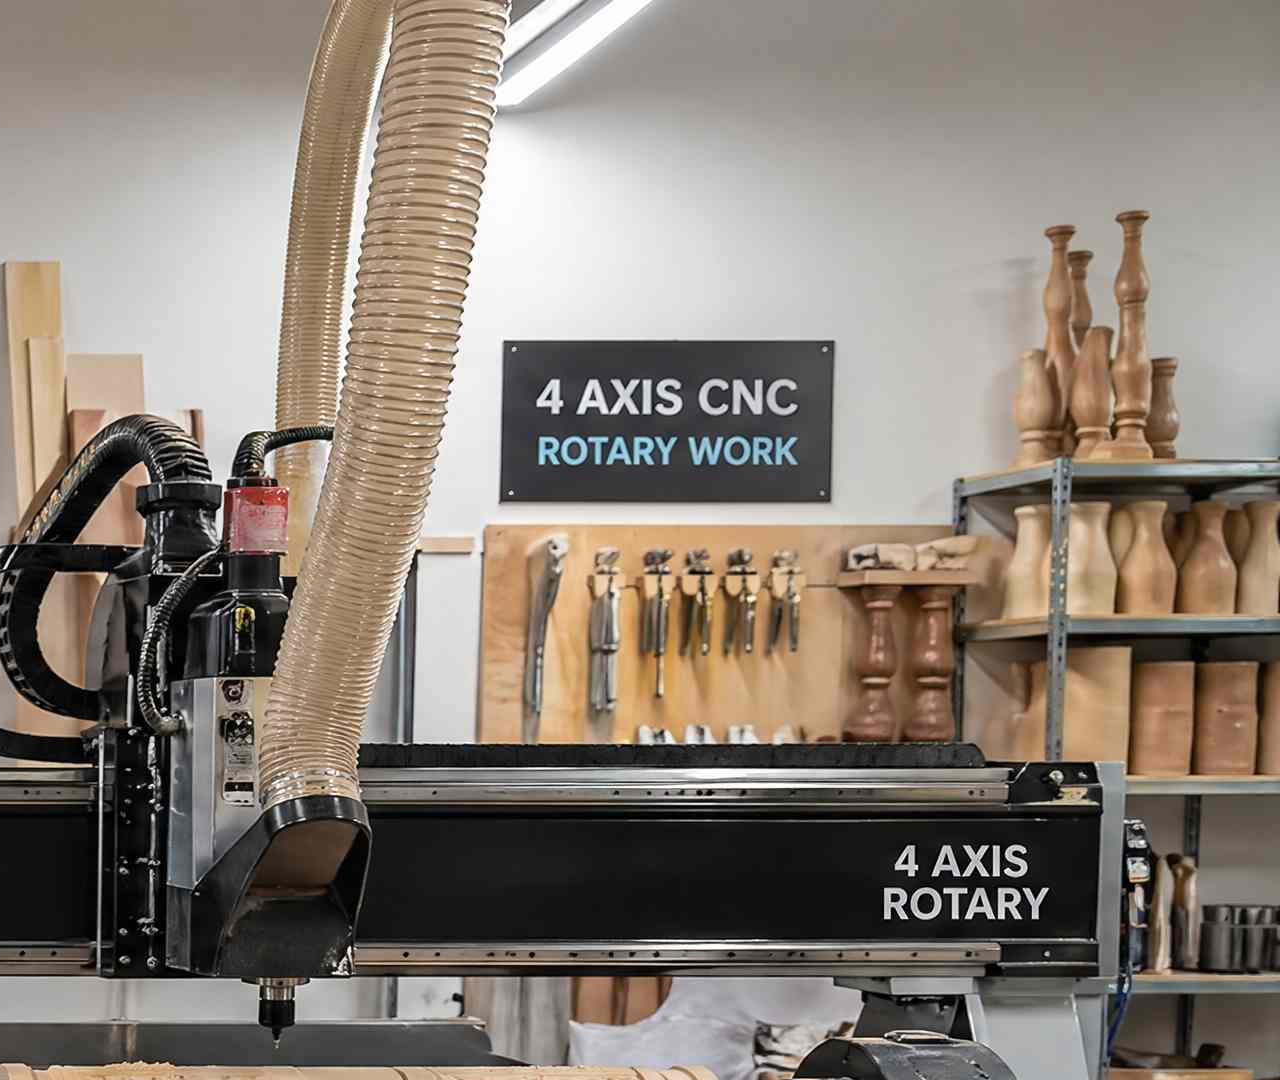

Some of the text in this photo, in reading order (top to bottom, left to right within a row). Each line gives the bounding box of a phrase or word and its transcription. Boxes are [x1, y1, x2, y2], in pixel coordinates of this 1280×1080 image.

[536, 378, 798, 416] 4 AXIS CNC
[538, 435, 798, 466] ROTARY WORK
[894, 844, 1029, 878] 4 AXIS
[883, 886, 1050, 921] ROTARY
